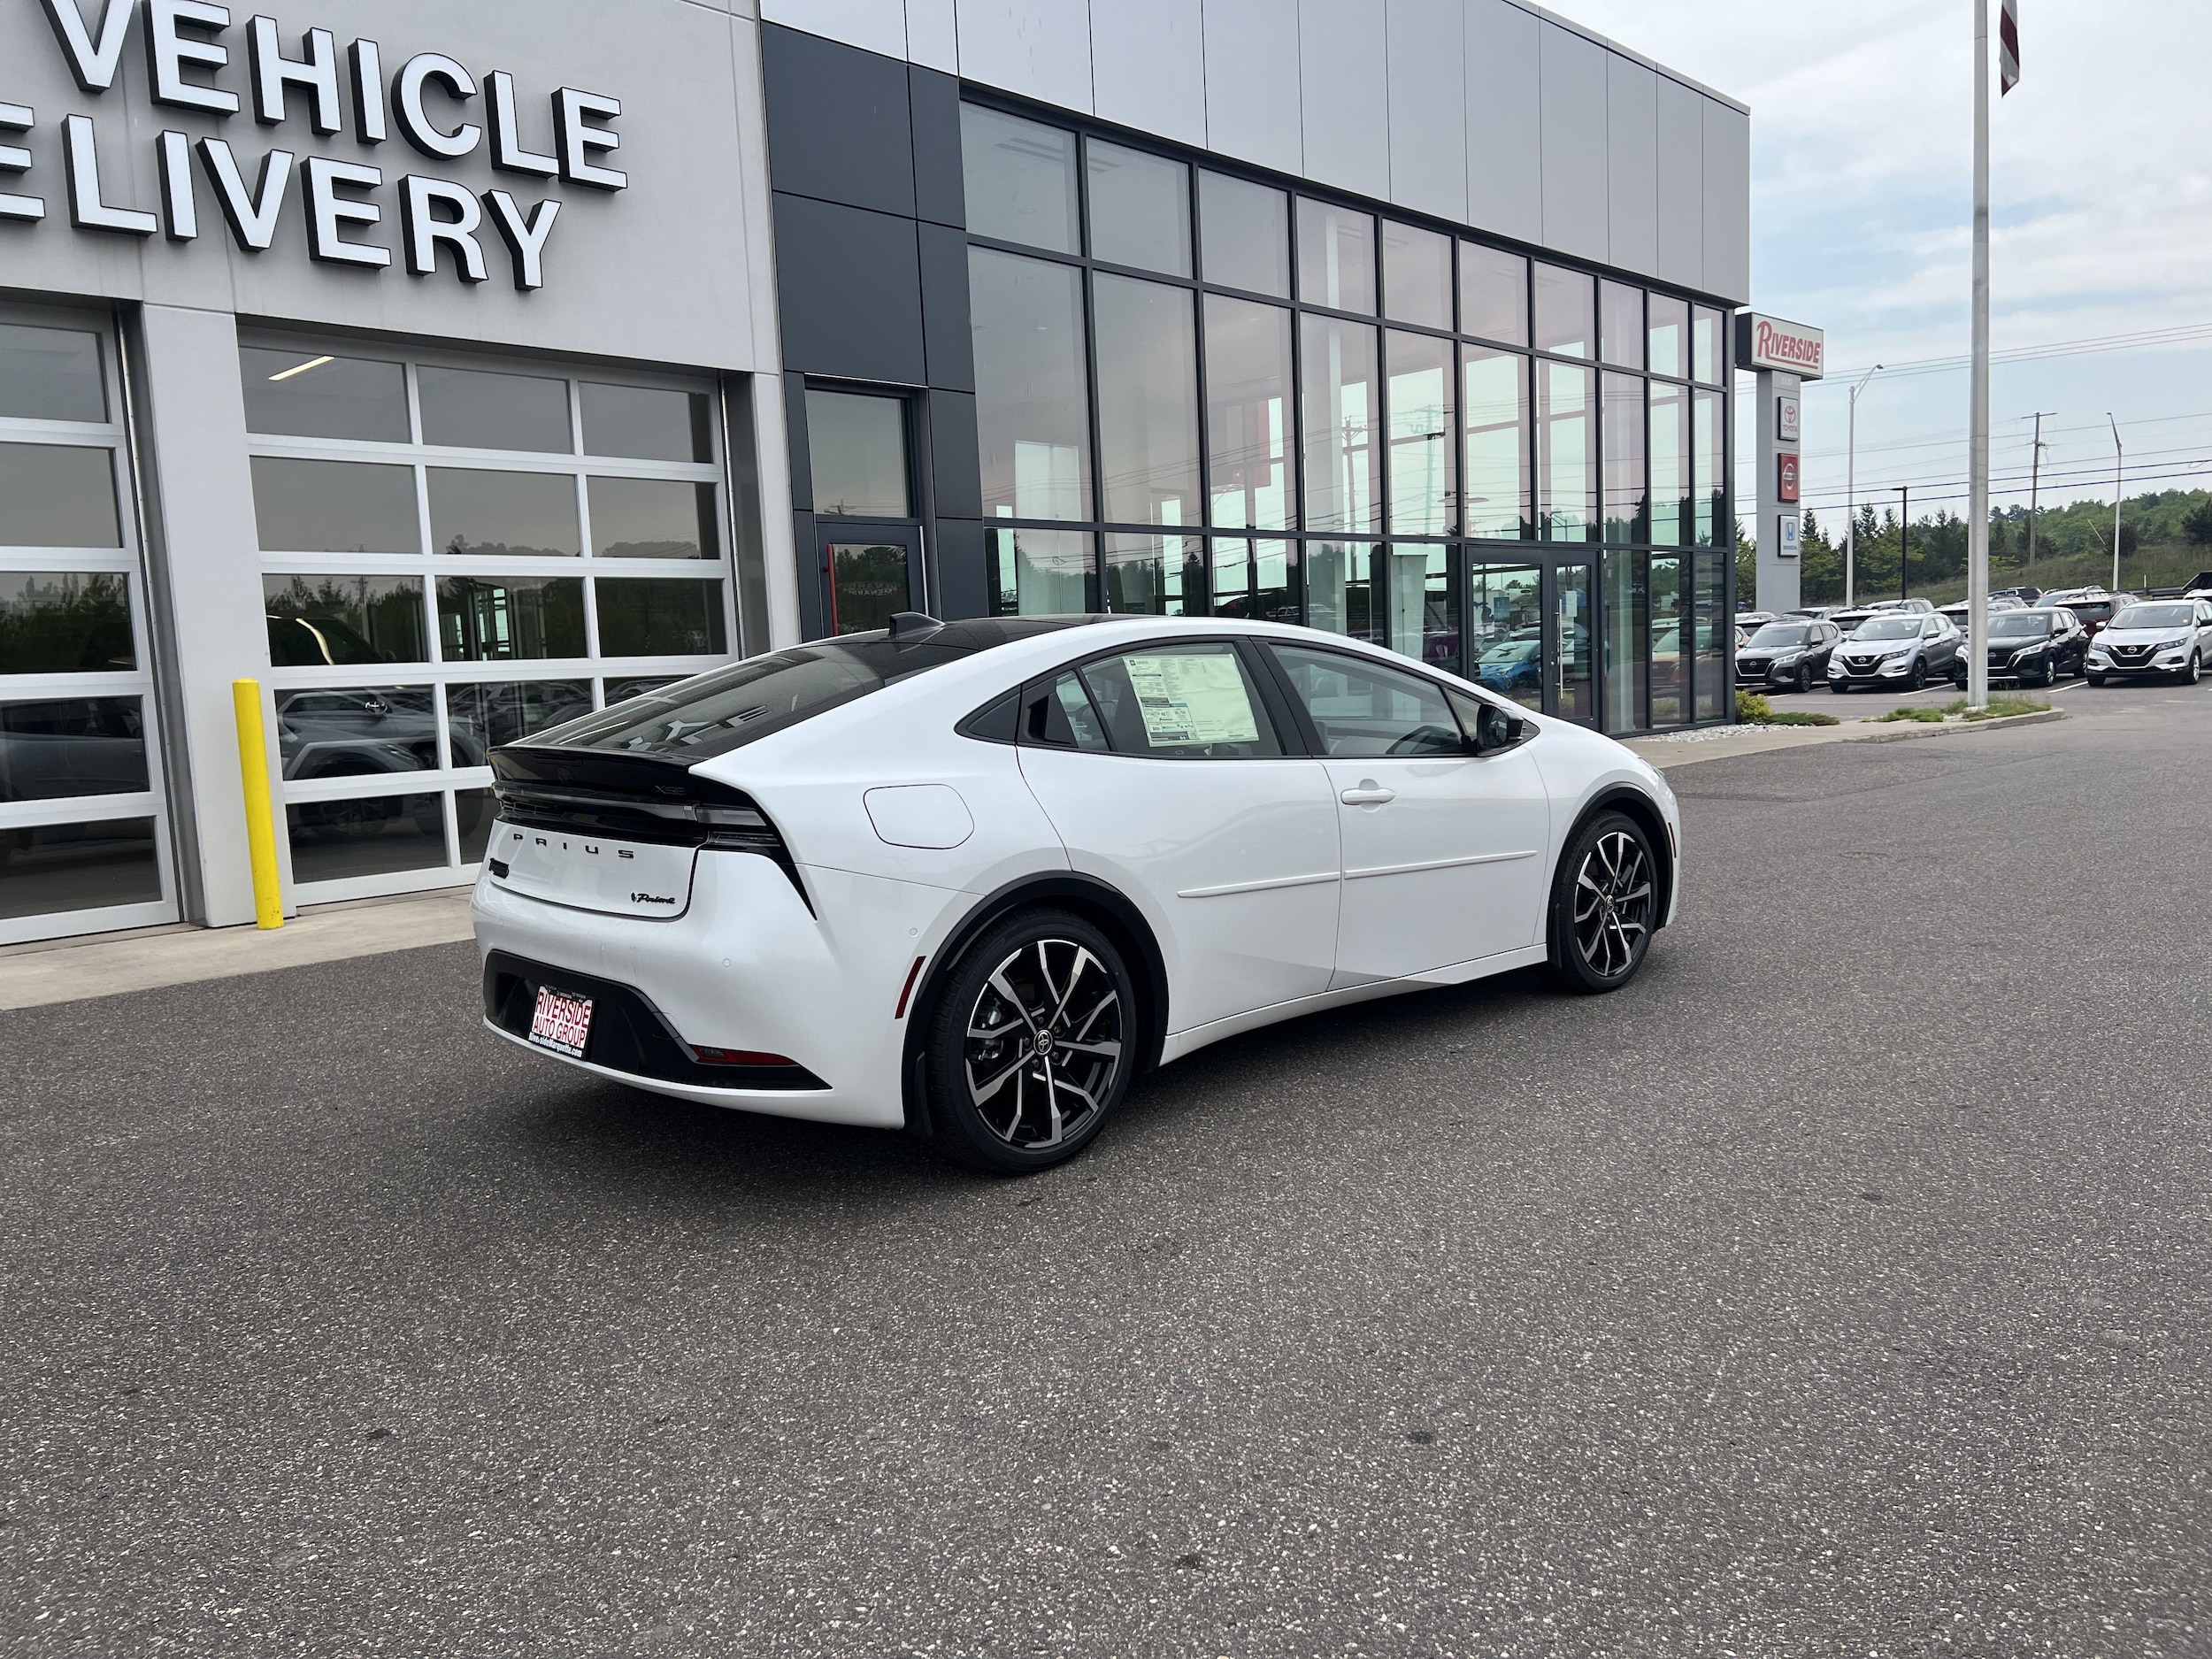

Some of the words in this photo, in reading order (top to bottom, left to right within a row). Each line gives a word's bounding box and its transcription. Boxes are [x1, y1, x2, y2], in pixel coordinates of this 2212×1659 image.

[46, 0, 628, 193] VEHICLE
[1756, 320, 1821, 365] RIVERSIDE
[655, 785, 687, 795] XSE
[513, 833, 634, 859] PRIUS
[636, 892, 676, 905] Prime
[535, 991, 592, 1029] RIVERSIDE
[533, 1014, 556, 1037] AUTO
[556, 1022, 586, 1046] GROUP
